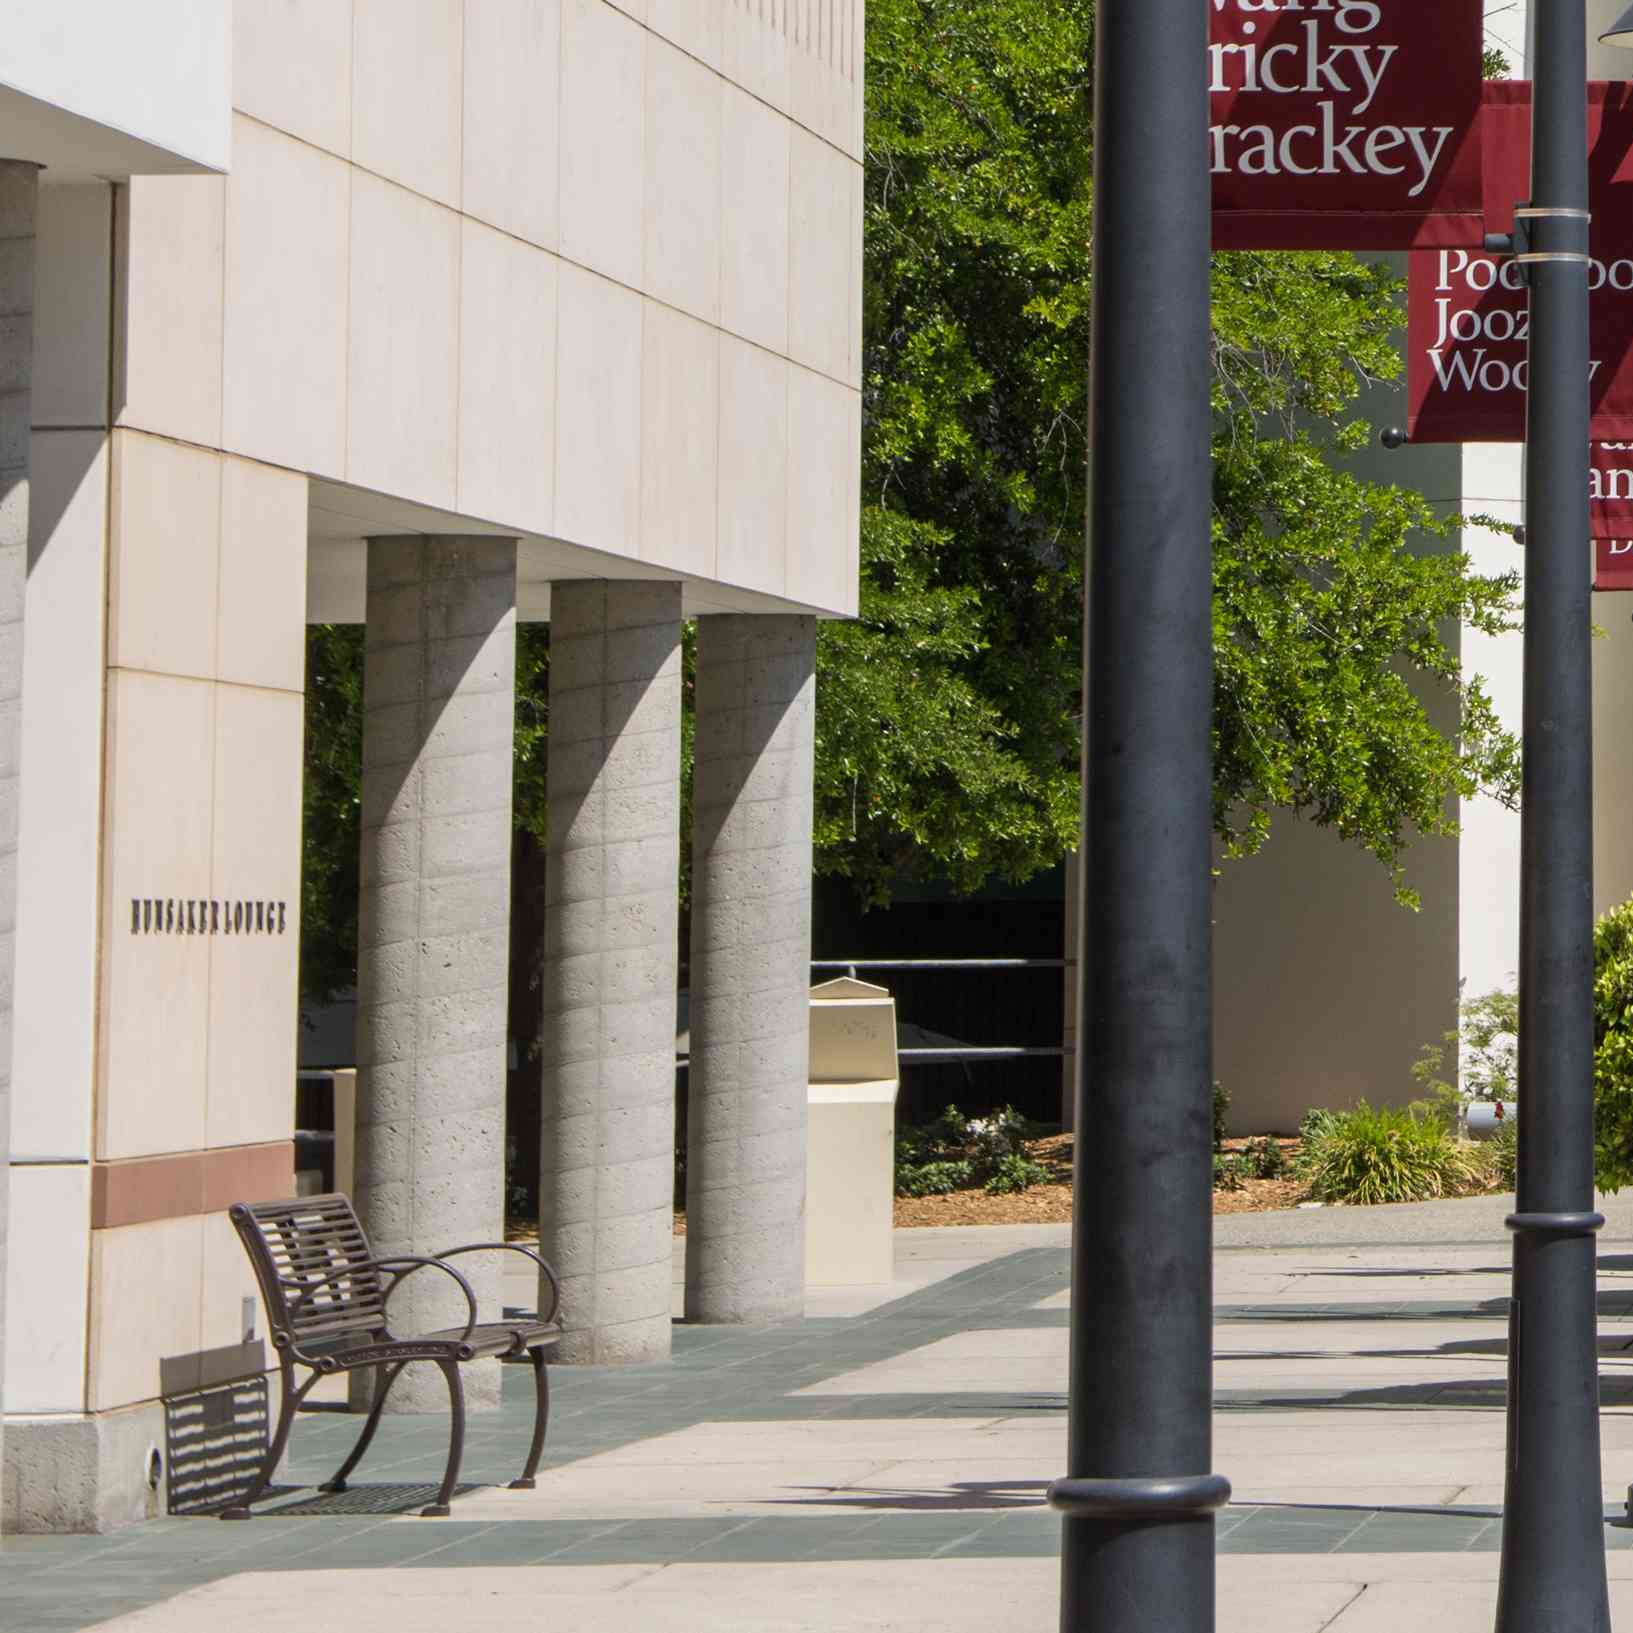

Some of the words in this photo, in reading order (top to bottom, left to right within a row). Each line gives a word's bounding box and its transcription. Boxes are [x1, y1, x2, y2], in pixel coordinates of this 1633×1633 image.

[1207, 20, 1399, 116] ricky
[1207, 100, 1454, 197] rackey
[1433, 297, 1529, 349] Jooz
[130, 898, 220, 935] HUNSAKER
[223, 900, 287, 935] LOUNGE
